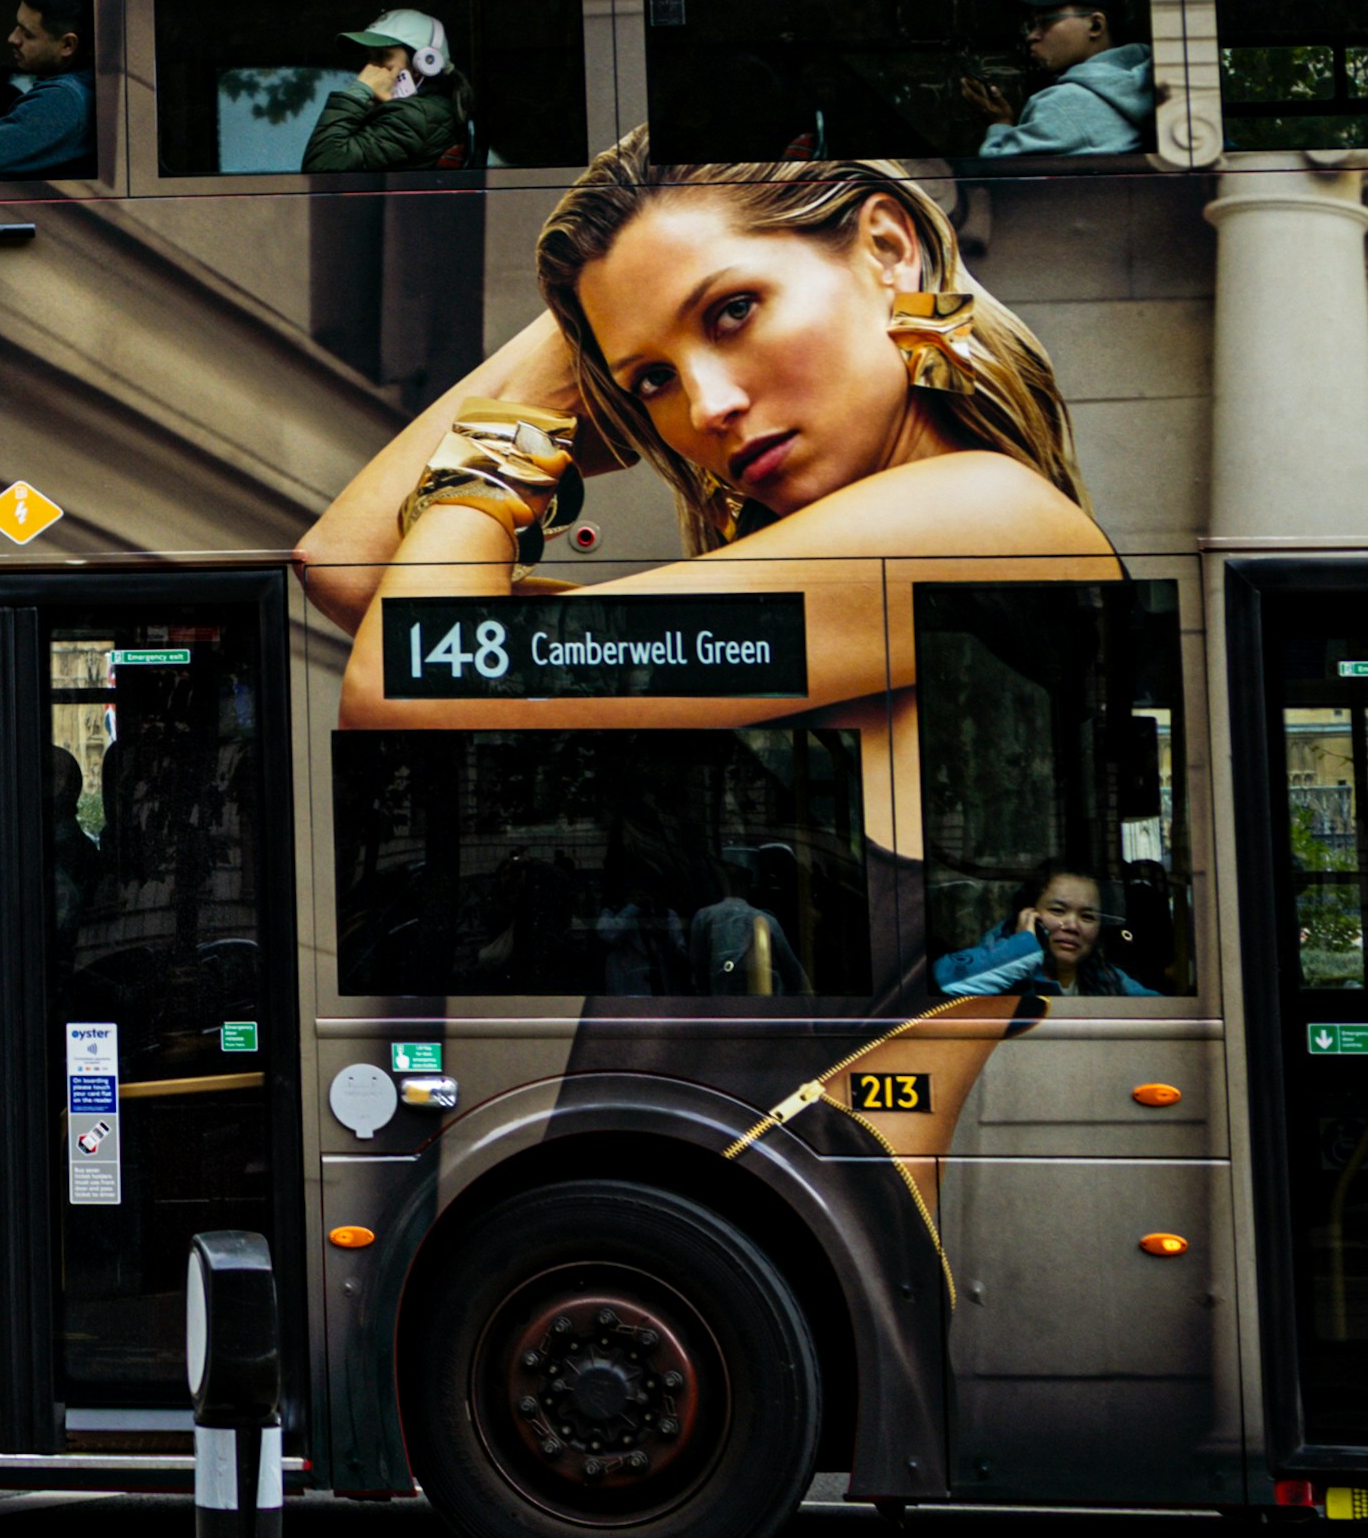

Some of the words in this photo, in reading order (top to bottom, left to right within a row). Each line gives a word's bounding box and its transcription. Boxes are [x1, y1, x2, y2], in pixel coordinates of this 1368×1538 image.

[128, 654, 167, 662] Emergency
[409, 620, 509, 679] 148
[531, 631, 687, 666] Camberwell
[696, 630, 771, 665] Green
[72, 1028, 109, 1040] oyster
[860, 1075, 919, 1109] 213
